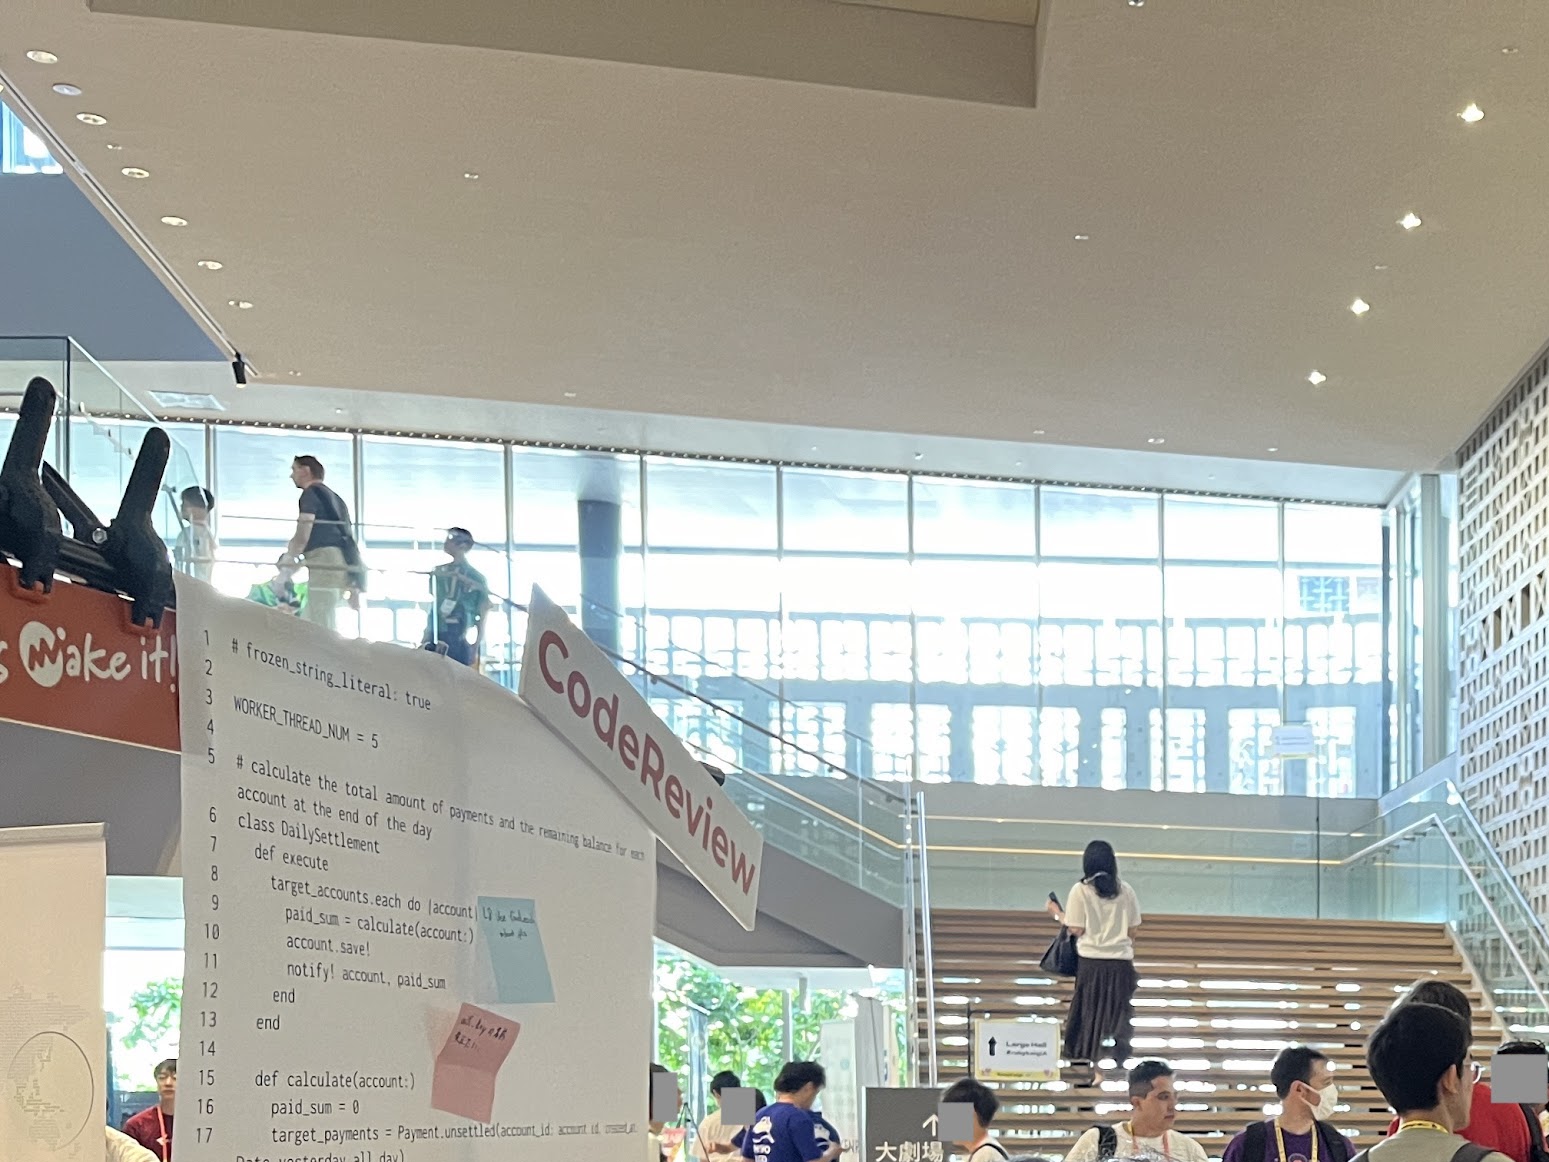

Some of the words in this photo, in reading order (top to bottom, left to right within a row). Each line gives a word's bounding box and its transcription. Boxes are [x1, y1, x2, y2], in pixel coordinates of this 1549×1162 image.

[204, 630, 210, 645] 1
[246, 642, 398, 701] frozen_string_literal:
[405, 691, 431, 711] true
[205, 690, 212, 705] 3
[234, 696, 350, 743] WORKER_THREAD_NUM
[371, 734, 378, 748] 5
[207, 749, 215, 764] 5
[539, 630, 756, 895] CodeReview
[237, 785, 286, 810] account
[293, 794, 307, 813] at
[313, 798, 332, 818] the
[338, 805, 359, 823] end
[365, 810, 378, 827] of
[387, 814, 407, 833] the
[412, 819, 432, 839] day
[251, 758, 311, 787] calculate
[318, 772, 338, 793] the
[346, 778, 378, 802] total
[386, 792, 425, 813] amount
[432, 798, 443, 814] of
[450, 805, 494, 827] payments
[499, 815, 515, 832] and
[520, 816, 535, 836] the
[539, 827, 579, 848] remaining
[210, 836, 217, 852] 7
[238, 814, 275, 834] class
[282, 821, 379, 855] DailySettlement
[255, 842, 276, 861] def
[282, 852, 328, 871] execute
[210, 866, 218, 881] 8
[211, 895, 219, 910] 9
[271, 875, 402, 909] target_accounts.each
[408, 898, 420, 912] do
[429, 899, 478, 921] |account|
[285, 905, 339, 927] paid_sum
[357, 914, 474, 943] calculate(account:)
[286, 935, 370, 956] account.save!
[203, 953, 218, 969] 11
[287, 961, 335, 982] notify!
[342, 967, 391, 986] account,
[397, 972, 446, 990] paid_sum
[273, 989, 295, 1004] end
[200, 1012, 217, 1027] 13
[256, 1015, 280, 1030] end
[199, 1070, 215, 1086] 15
[255, 1072, 277, 1087] def
[287, 1071, 415, 1090] calculate(account:)
[271, 1099, 332, 1117] paid_sum
[196, 1127, 213, 1143] 17
[272, 1126, 379, 1145] target_payments
[875, 1141, 944, 1162] 大劇場
